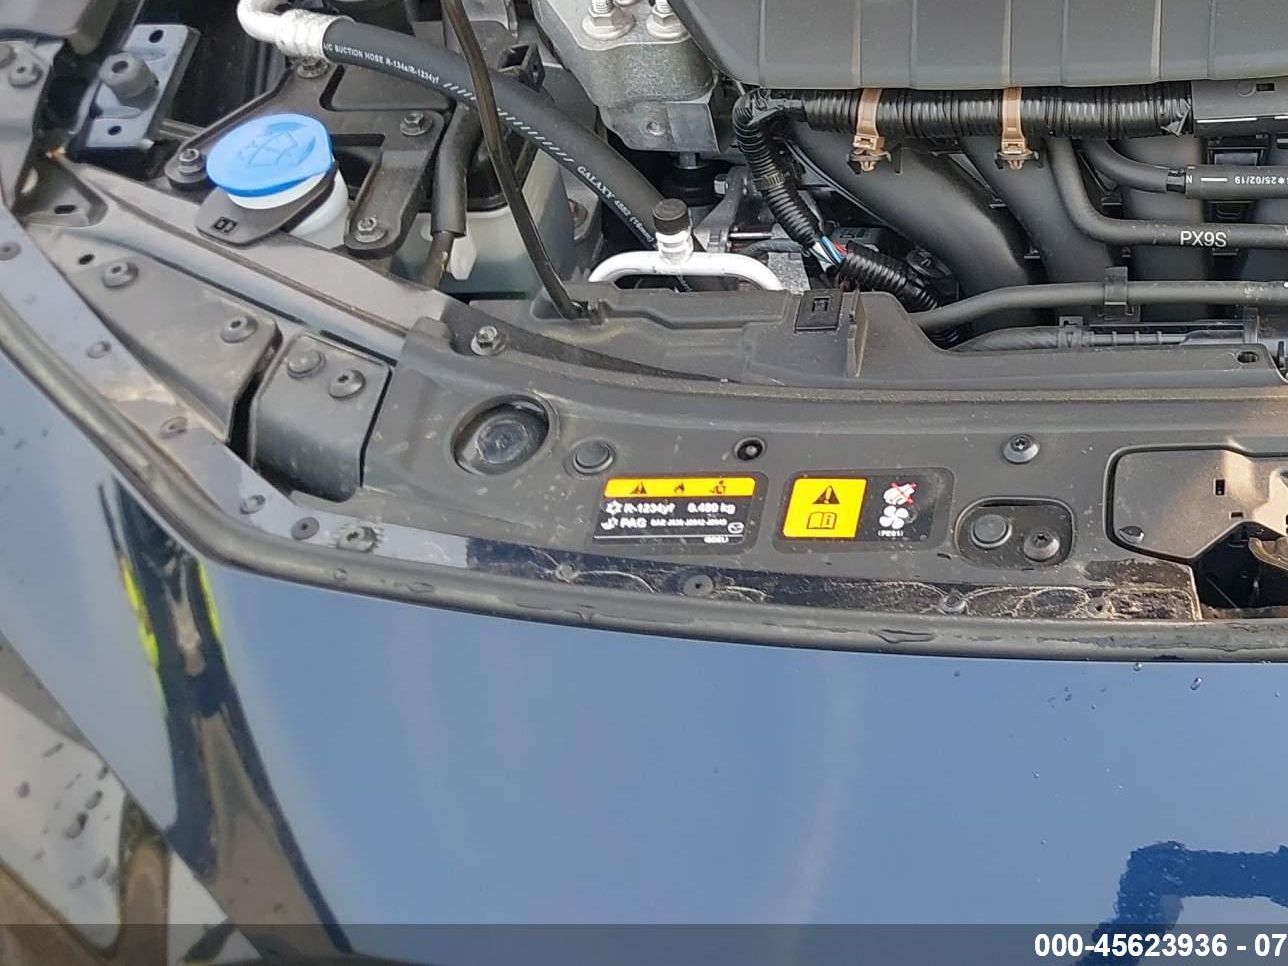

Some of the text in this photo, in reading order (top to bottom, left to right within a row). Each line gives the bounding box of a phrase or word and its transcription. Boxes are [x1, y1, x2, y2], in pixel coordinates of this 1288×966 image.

[334, 44, 363, 58] SUCTION
[364, 52, 384, 64] HOSE
[577, 165, 615, 199] GALAXY
[1180, 230, 1227, 248] PX9S
[720, 502, 737, 515] kg
[619, 517, 648, 529] PAG
